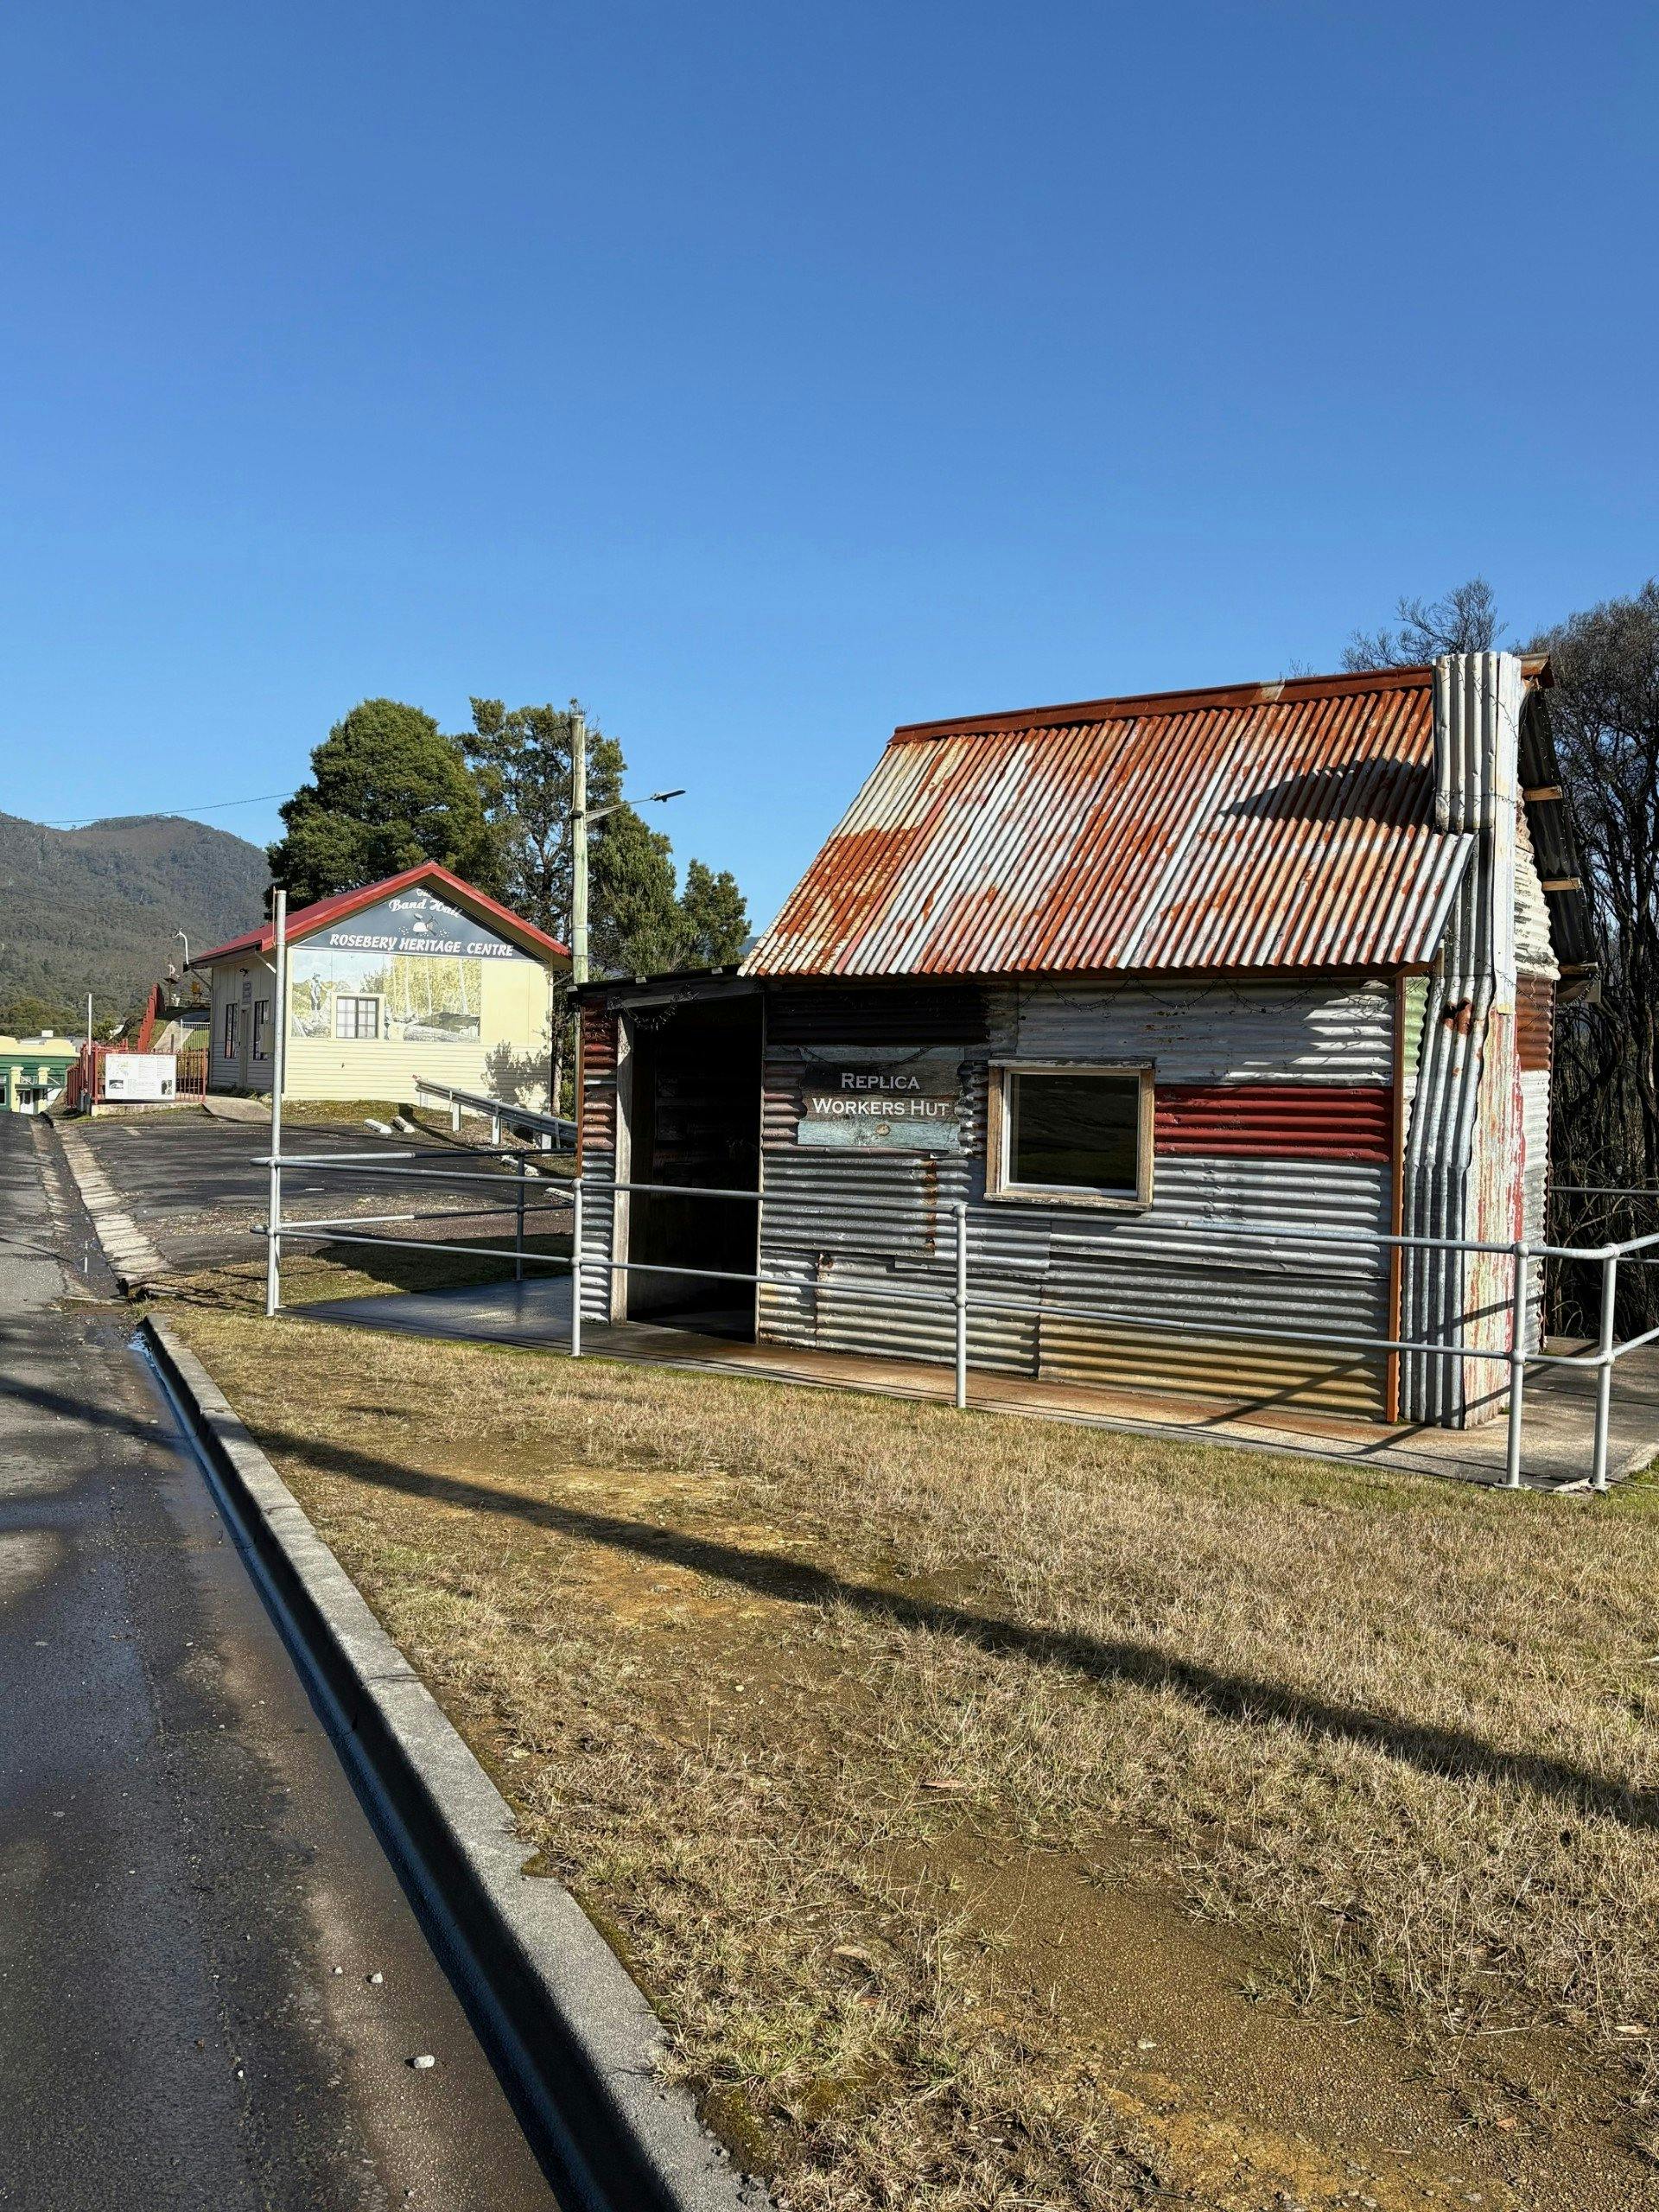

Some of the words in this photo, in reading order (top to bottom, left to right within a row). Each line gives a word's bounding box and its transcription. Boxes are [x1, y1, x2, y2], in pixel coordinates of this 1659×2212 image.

[389, 899, 427, 912] Band
[429, 899, 463, 918] Hall
[329, 933, 397, 950] ROSEBERY
[399, 938, 461, 953] HERITAGE
[467, 942, 514, 957] CENTRE
[841, 1072, 920, 1090] REPLICA
[812, 1097, 905, 1116] WORKERS
[910, 1100, 950, 1116] HUT
